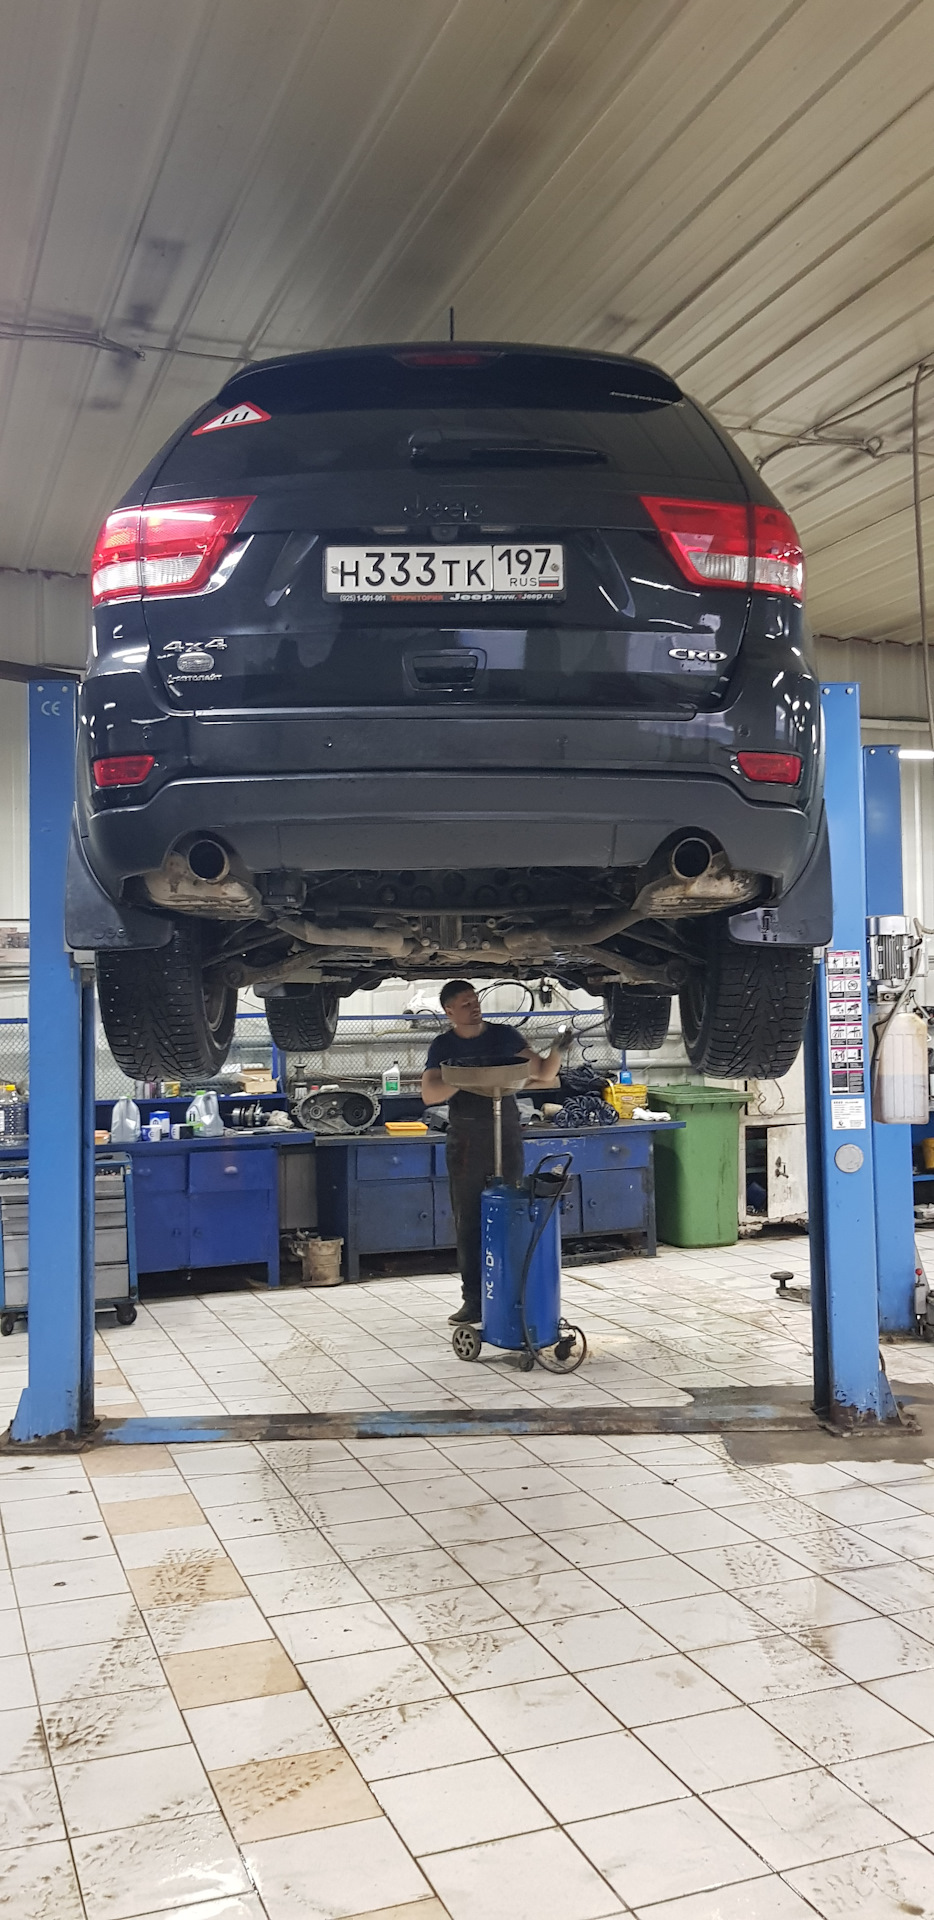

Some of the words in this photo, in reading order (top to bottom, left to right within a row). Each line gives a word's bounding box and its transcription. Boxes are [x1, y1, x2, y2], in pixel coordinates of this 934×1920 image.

[498, 548, 551, 575] 197
[509, 577, 537, 587] RUS
[450, 593, 493, 602] Jeep
[668, 648, 728, 661] CRD
[41, 700, 61, 716] CE
